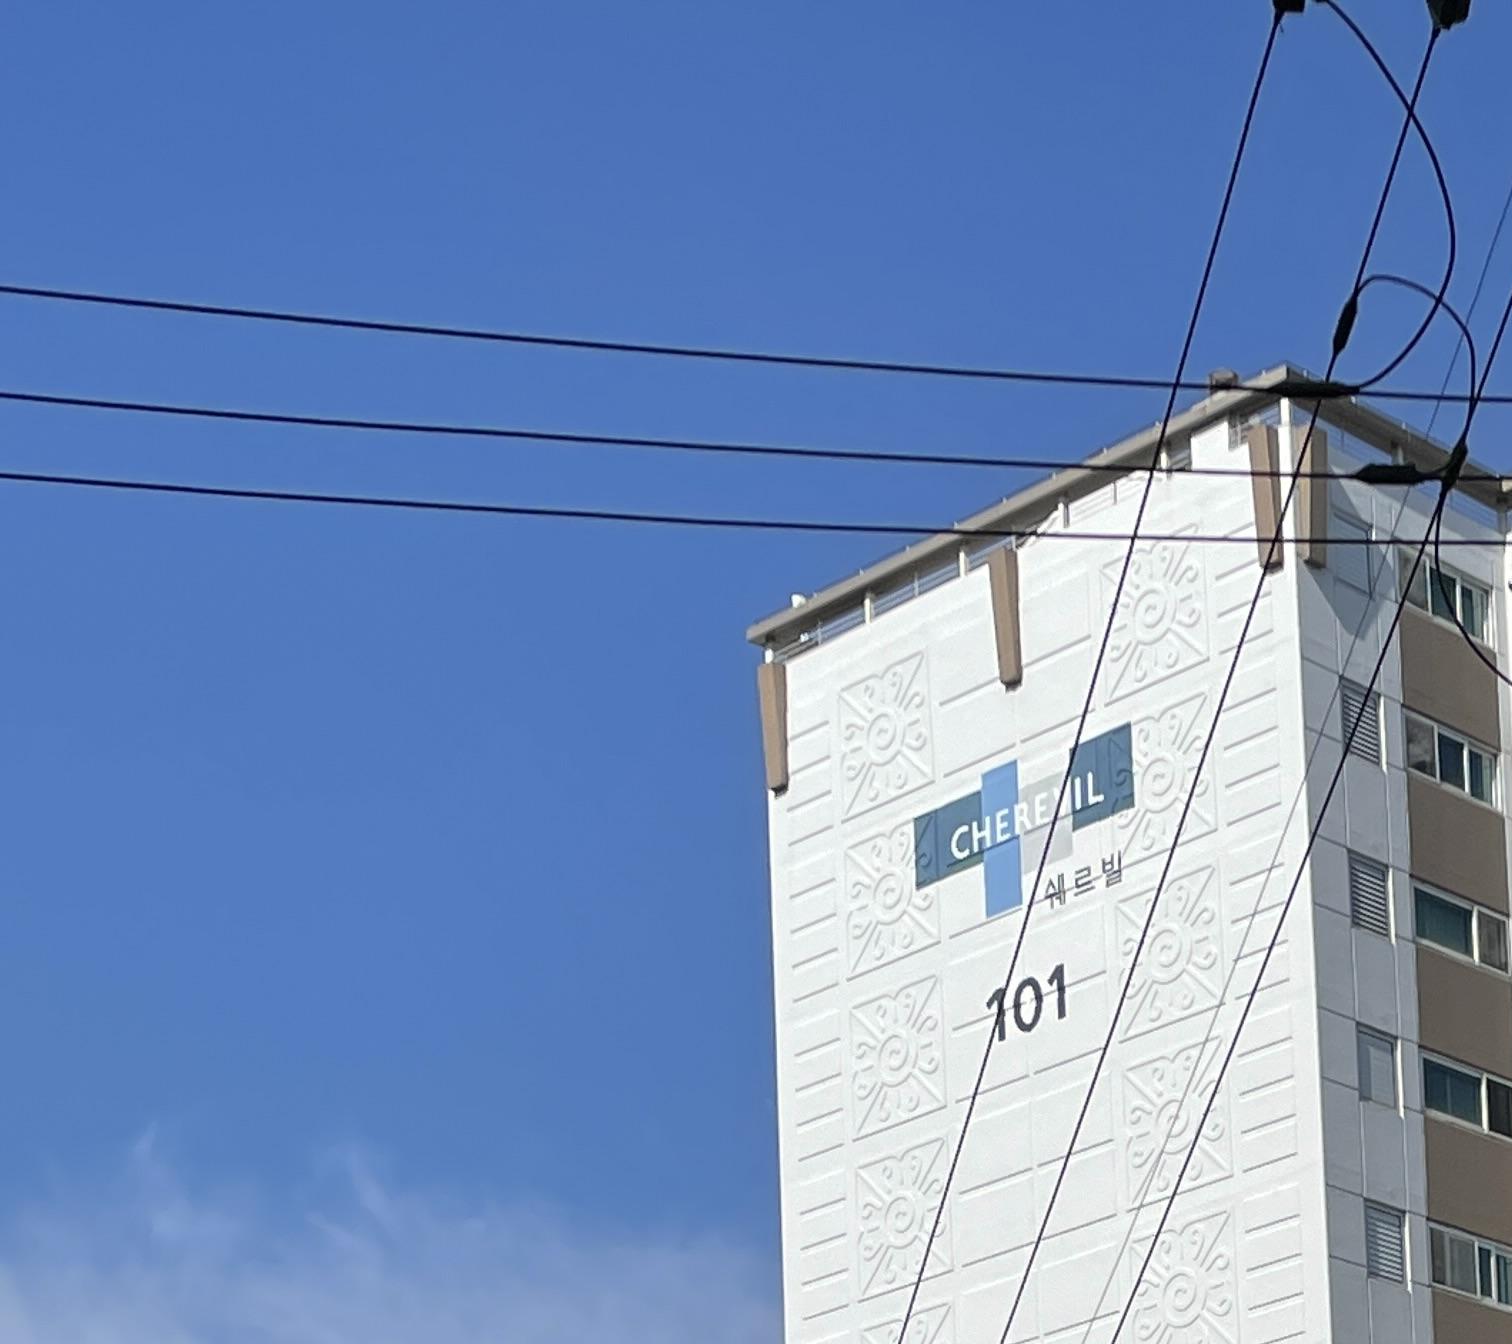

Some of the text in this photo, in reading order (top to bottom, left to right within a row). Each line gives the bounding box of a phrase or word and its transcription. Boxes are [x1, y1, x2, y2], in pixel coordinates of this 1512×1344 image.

[949, 770, 1105, 861] CHEREVIL
[1043, 850, 1123, 910] 쉐르빌
[985, 963, 1067, 1042] 101
